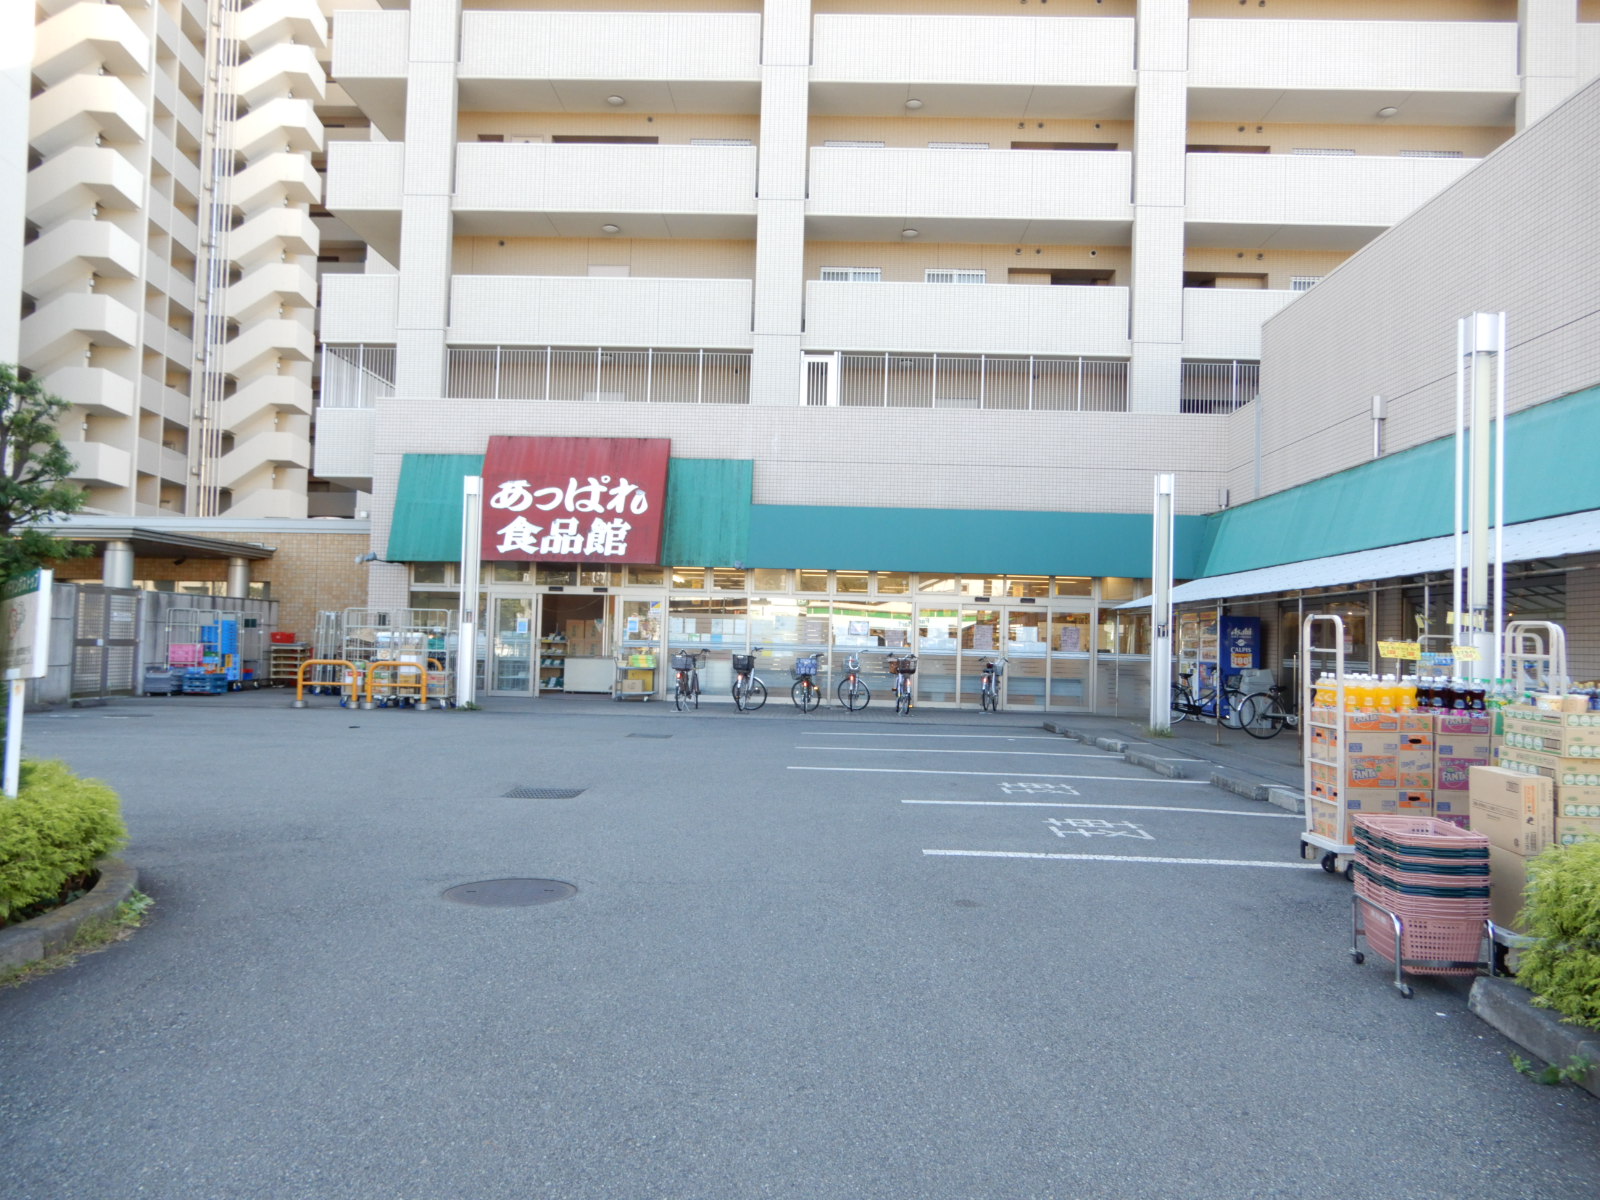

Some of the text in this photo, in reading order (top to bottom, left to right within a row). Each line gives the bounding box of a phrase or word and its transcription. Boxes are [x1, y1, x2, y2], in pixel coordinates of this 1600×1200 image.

[489, 475, 649, 515] あっぱれ
[496, 515, 632, 556] 食品館
[1230, 627, 1252, 636] Asahi
[1352, 767, 1378, 781] FANTA
[1442, 771, 1467, 783] FANTA
[1041, 817, 1156, 840] 軽
